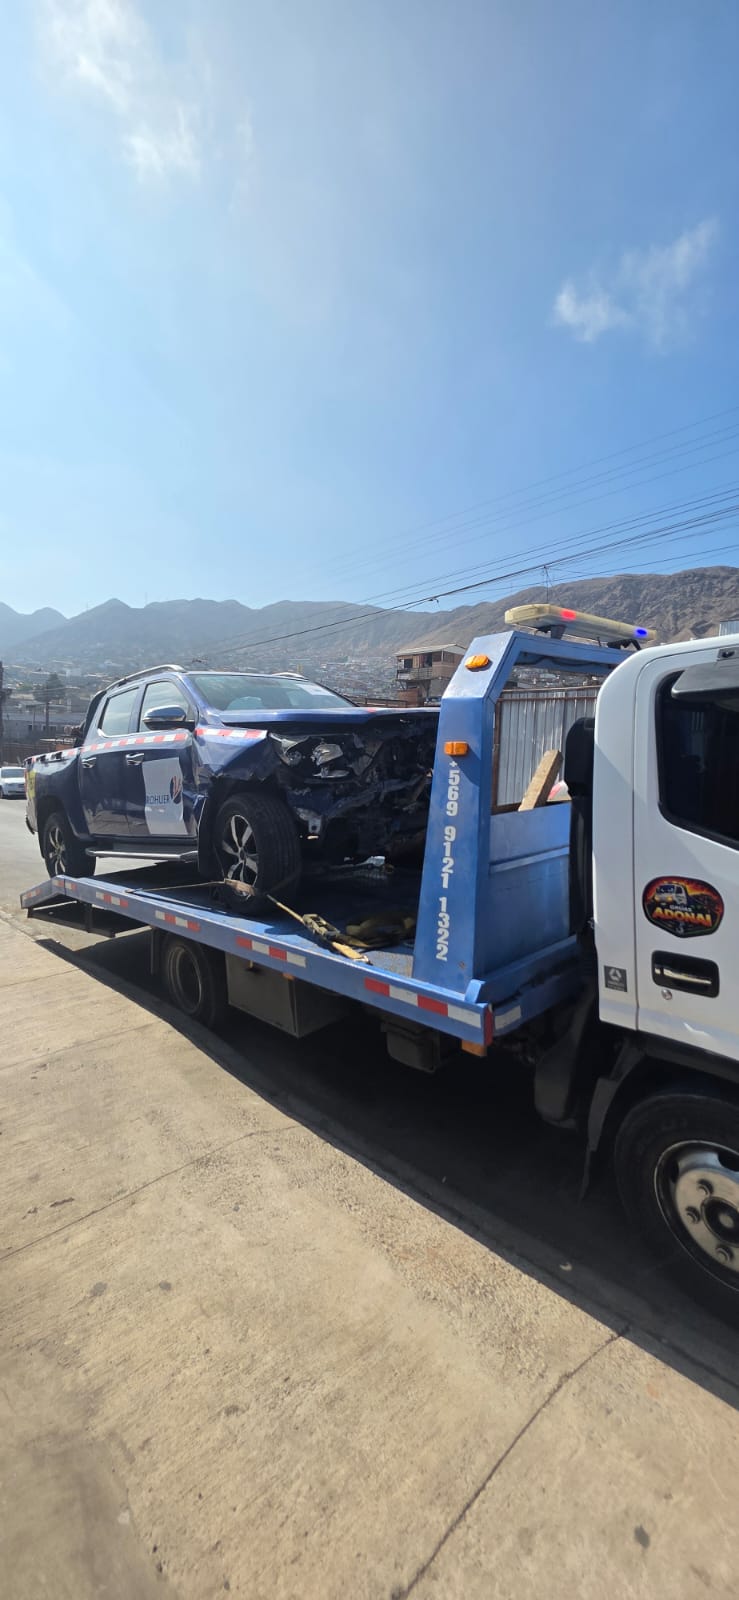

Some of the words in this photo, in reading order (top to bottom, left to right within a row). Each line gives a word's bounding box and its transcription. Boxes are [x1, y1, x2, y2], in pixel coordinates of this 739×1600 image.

[446, 761, 460, 816] +569
[441, 826, 456, 889] 9121
[435, 896, 450, 961] 1322
[652, 907, 713, 928] ADONAI
